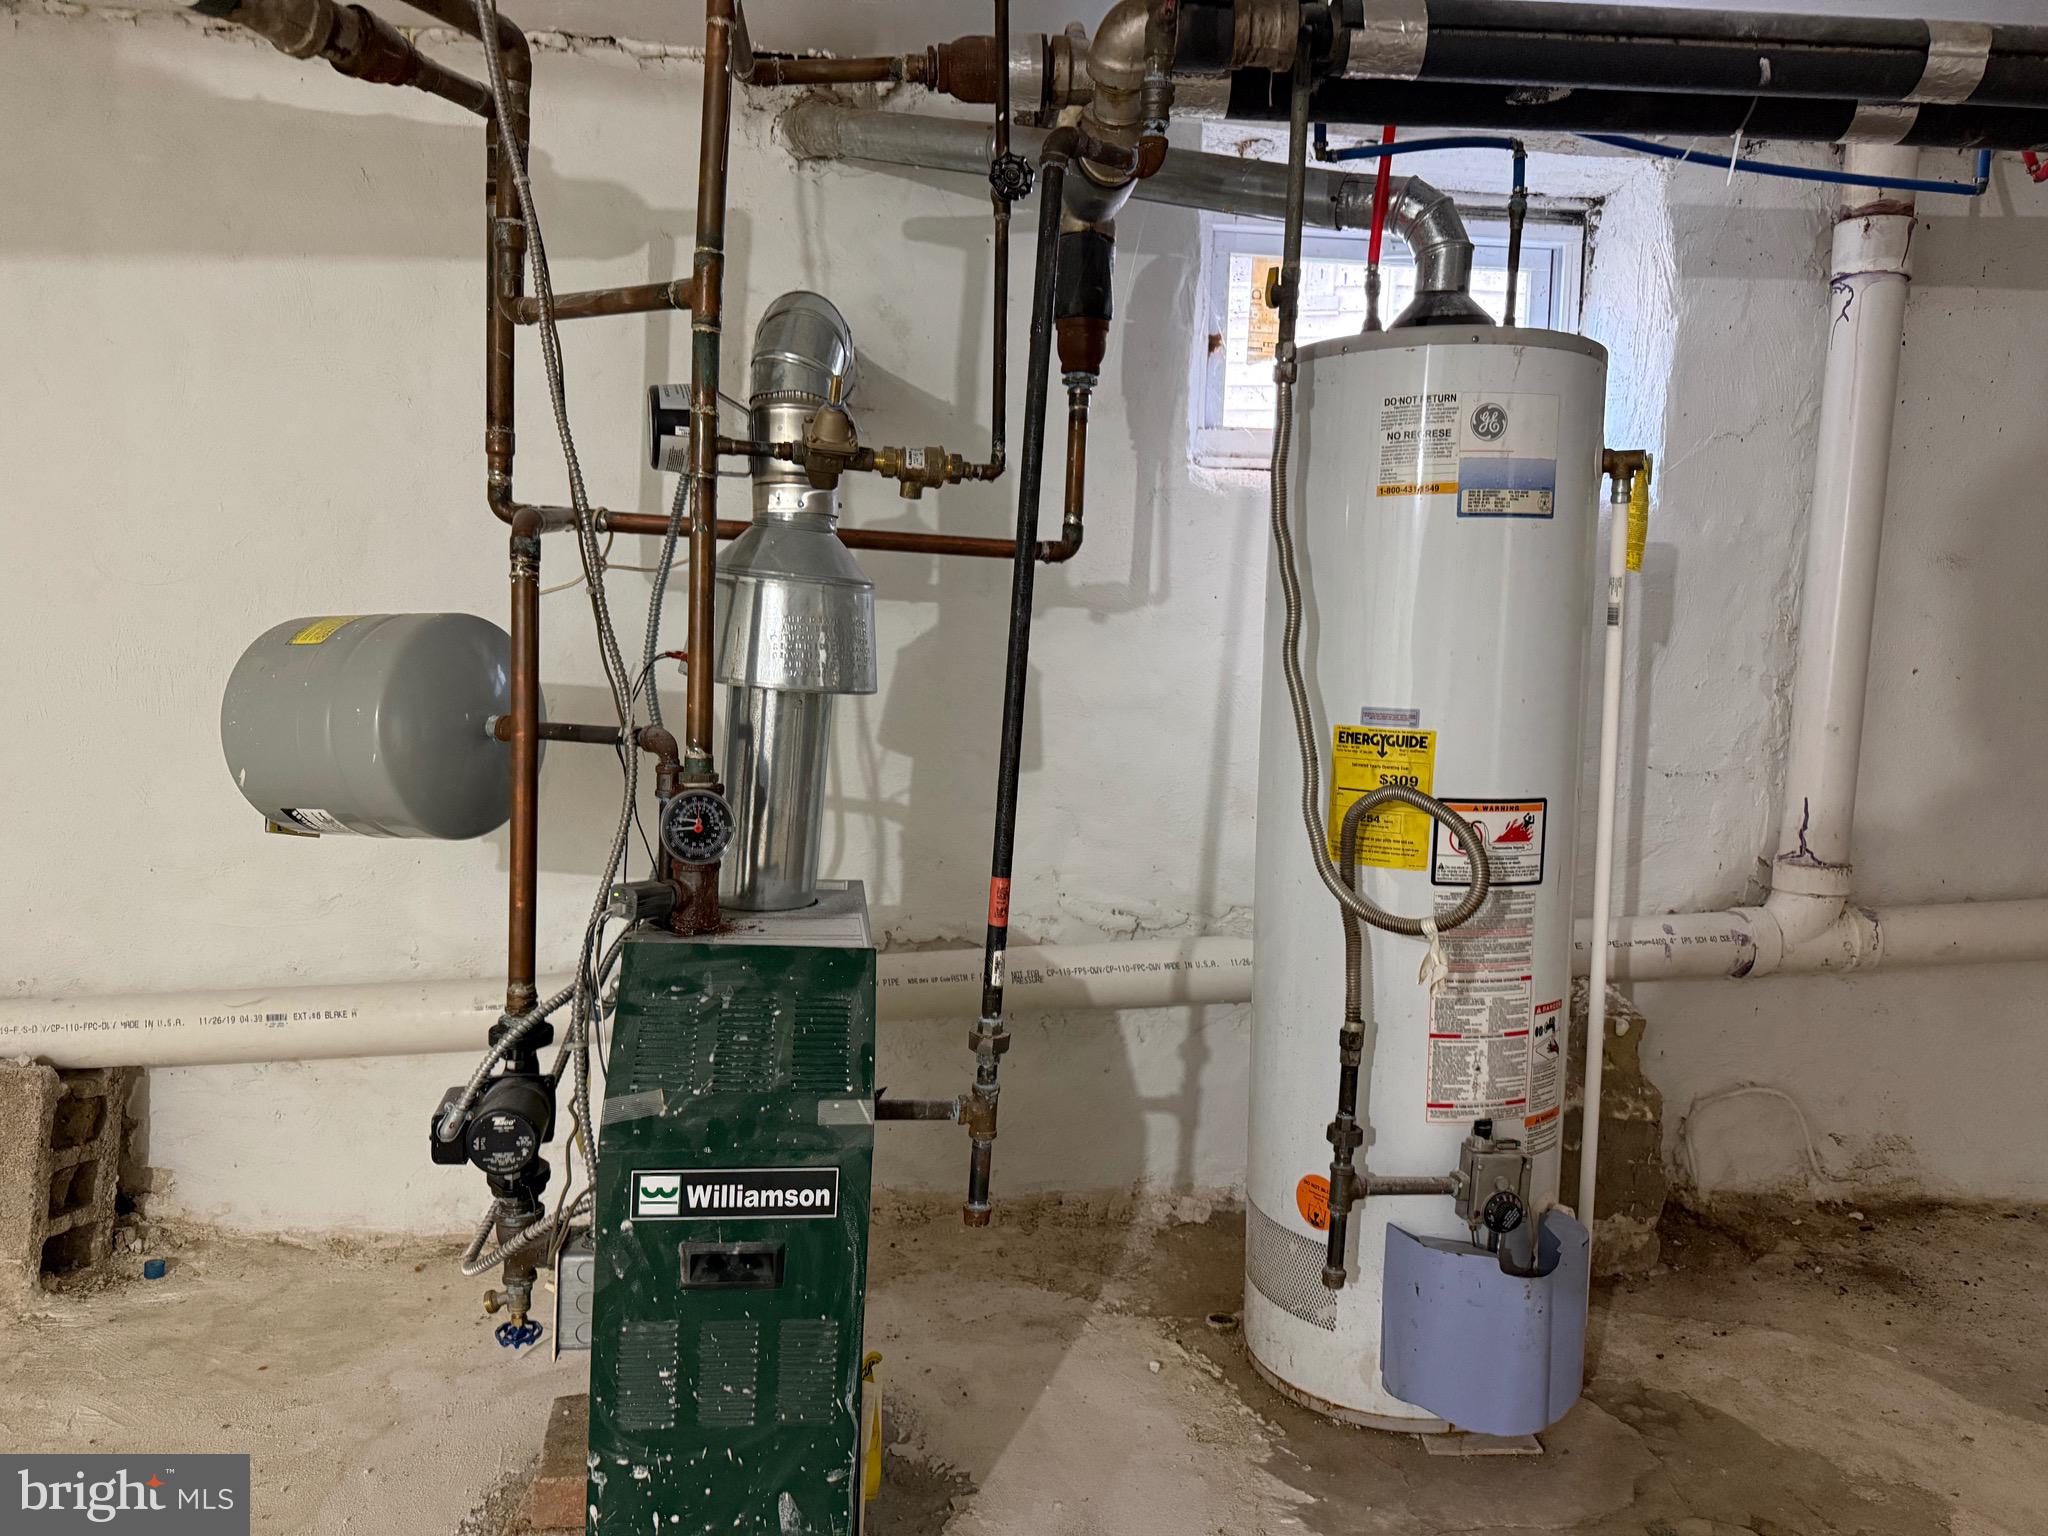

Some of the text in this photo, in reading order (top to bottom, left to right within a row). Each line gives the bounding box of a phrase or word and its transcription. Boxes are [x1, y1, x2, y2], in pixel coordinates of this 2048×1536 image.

[1384, 398, 1397, 407] DO
[1399, 395, 1417, 405] NOT
[1387, 431, 1401, 441] NO
[1338, 731, 1428, 750] ENERGYGUIDE
[1184, 960, 1193, 969] IN
[144, 1018, 154, 1029] IN
[199, 1015, 236, 1025] 11/26/19
[686, 1183, 831, 1209] Williamson
